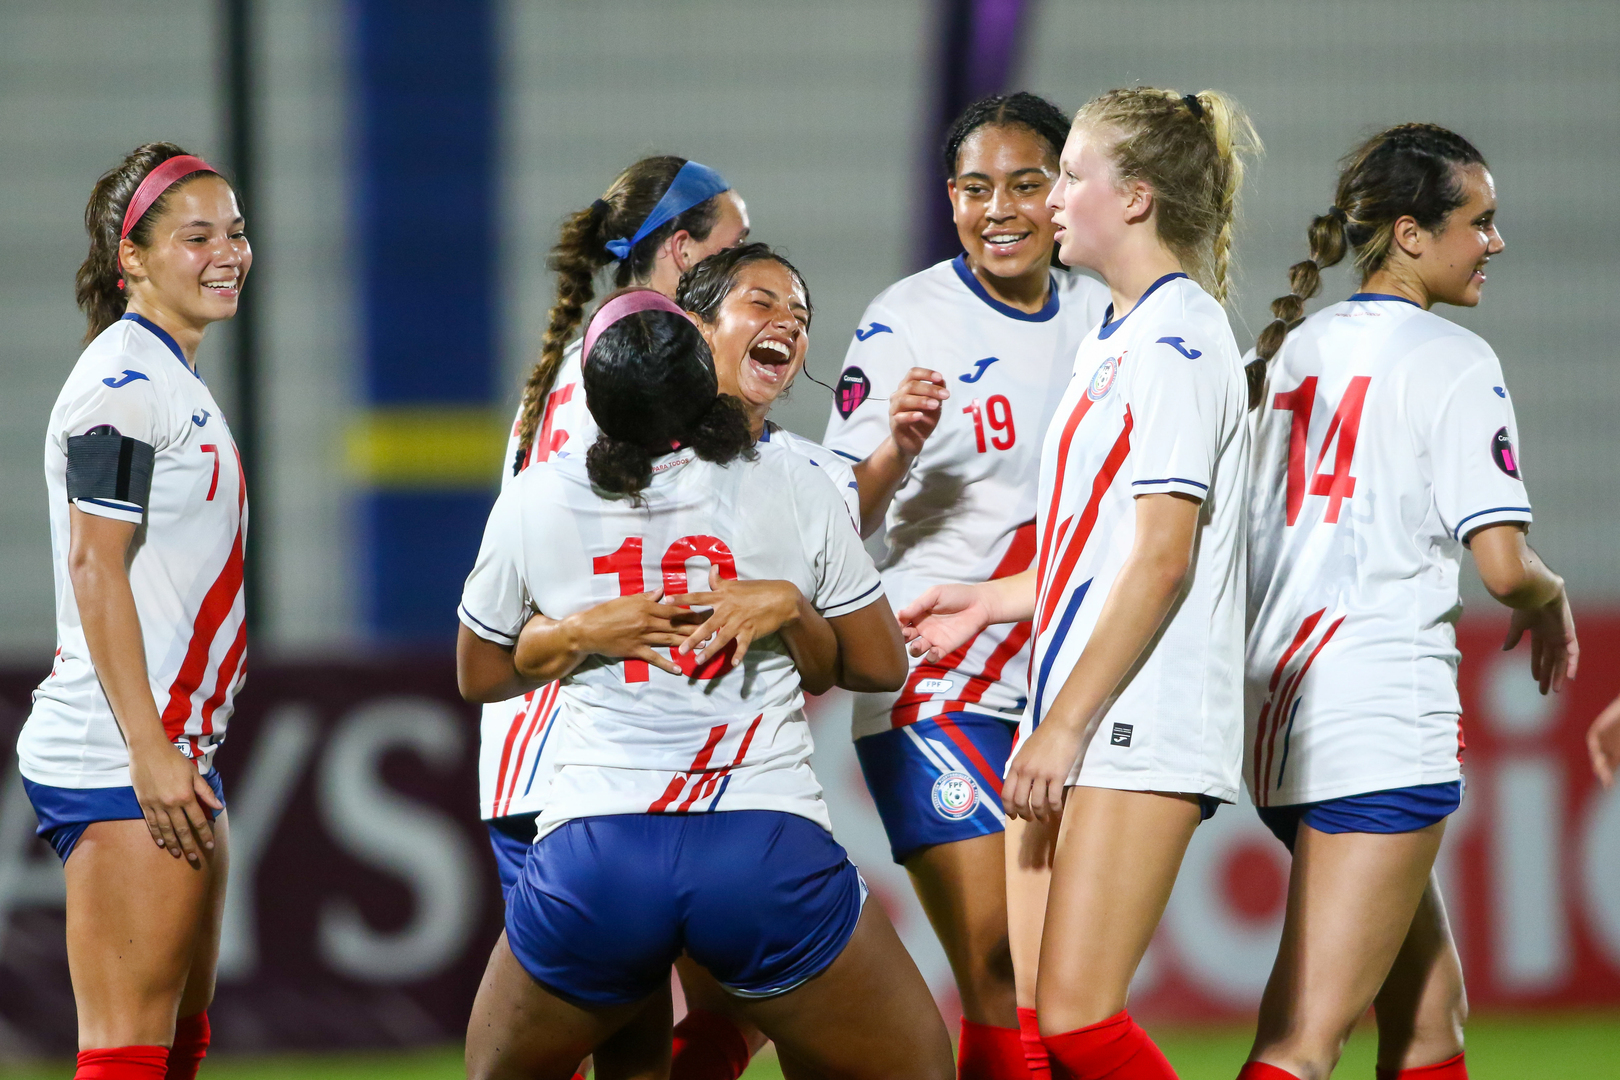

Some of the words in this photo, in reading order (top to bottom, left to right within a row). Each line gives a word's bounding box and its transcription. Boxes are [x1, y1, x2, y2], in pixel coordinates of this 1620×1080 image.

[962, 393, 1017, 454] 19
[1273, 375, 1372, 526] 14
[200, 444, 219, 502] 7
[651, 463, 669, 473] PARA
[668, 457, 690, 468] TODOS
[593, 534, 740, 684] 10
[926, 680, 942, 688] FPF
[948, 780, 963, 789] FPF
